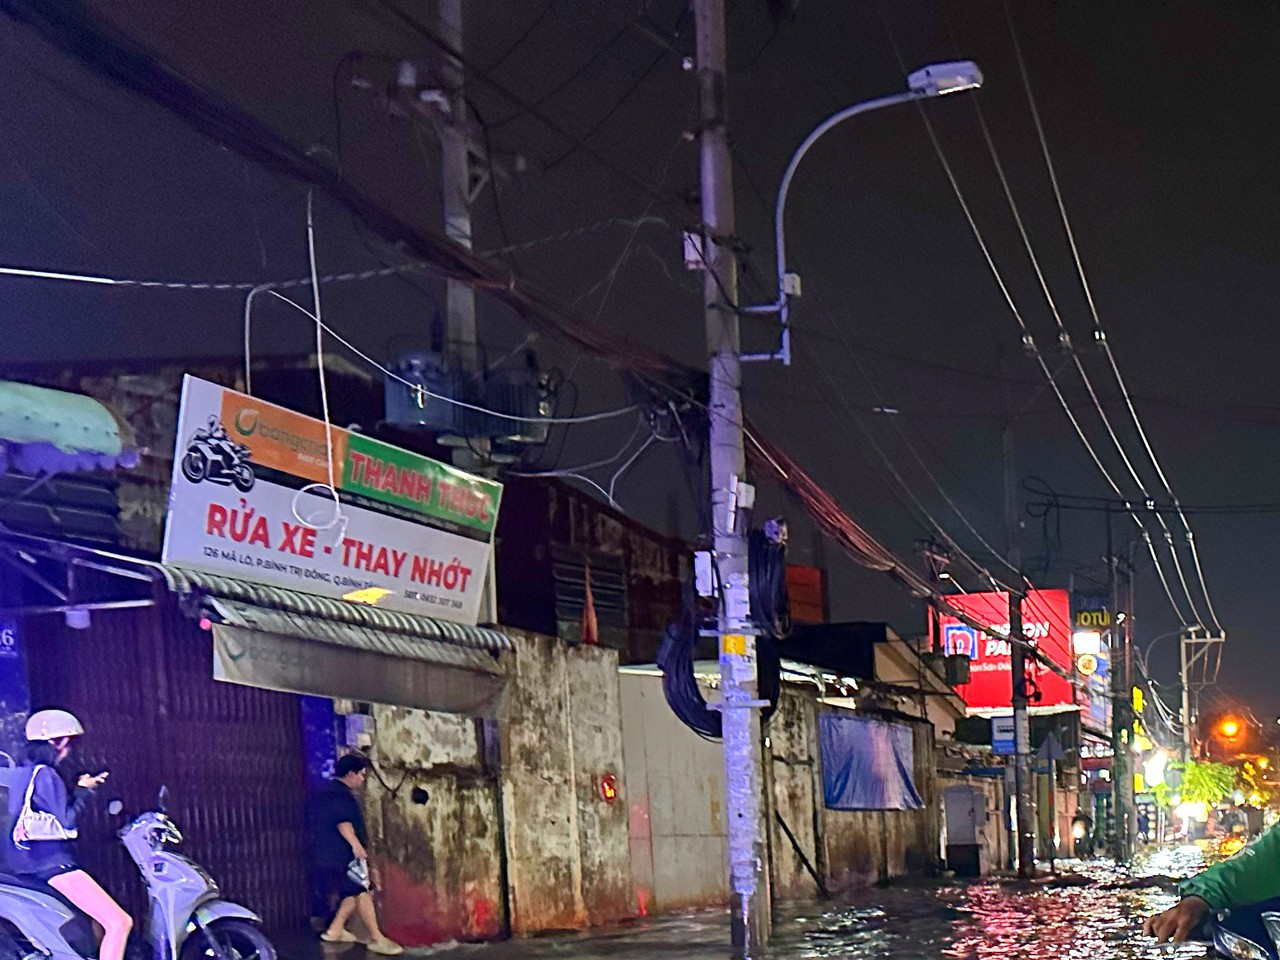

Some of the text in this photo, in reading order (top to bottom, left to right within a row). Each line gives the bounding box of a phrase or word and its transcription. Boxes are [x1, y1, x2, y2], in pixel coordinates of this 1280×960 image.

[349, 450, 433, 505] THANH
[205, 498, 271, 549] RỬA
[278, 521, 318, 559] XE
[341, 537, 408, 578] THAY
[410, 555, 472, 593] NHỚT
[1076, 610, 1111, 627] JOTU
[0, 628, 15, 647] 6
